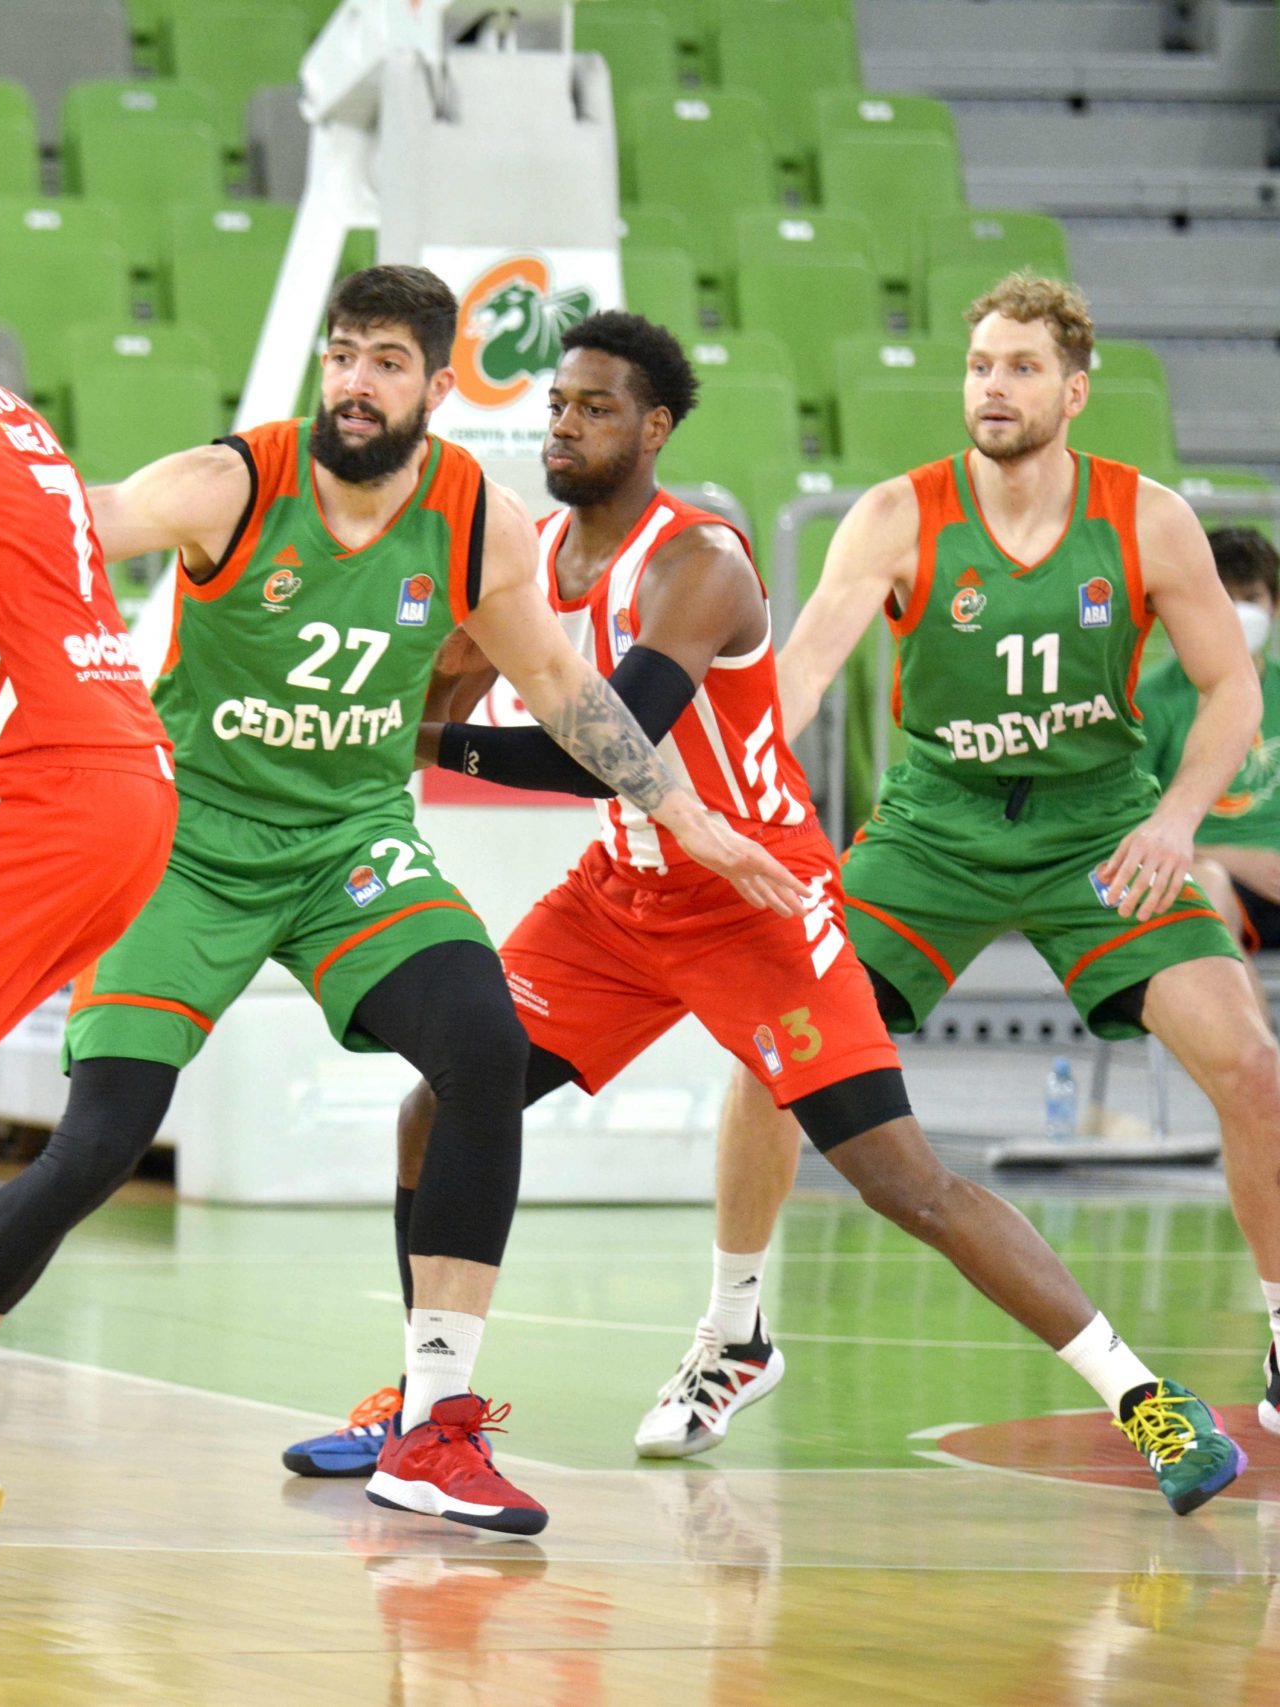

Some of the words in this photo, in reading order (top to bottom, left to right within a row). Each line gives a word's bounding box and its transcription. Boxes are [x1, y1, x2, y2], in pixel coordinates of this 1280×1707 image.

[28, 464, 94, 602] 7
[400, 602, 425, 622] ABA
[1083, 605, 1108, 624] ABA
[286, 621, 391, 695] 27
[996, 632, 1060, 696] 11
[212, 696, 404, 751] CEDEVITA
[780, 1006, 823, 1062] 3
[417, 1348, 456, 1356] adidas
